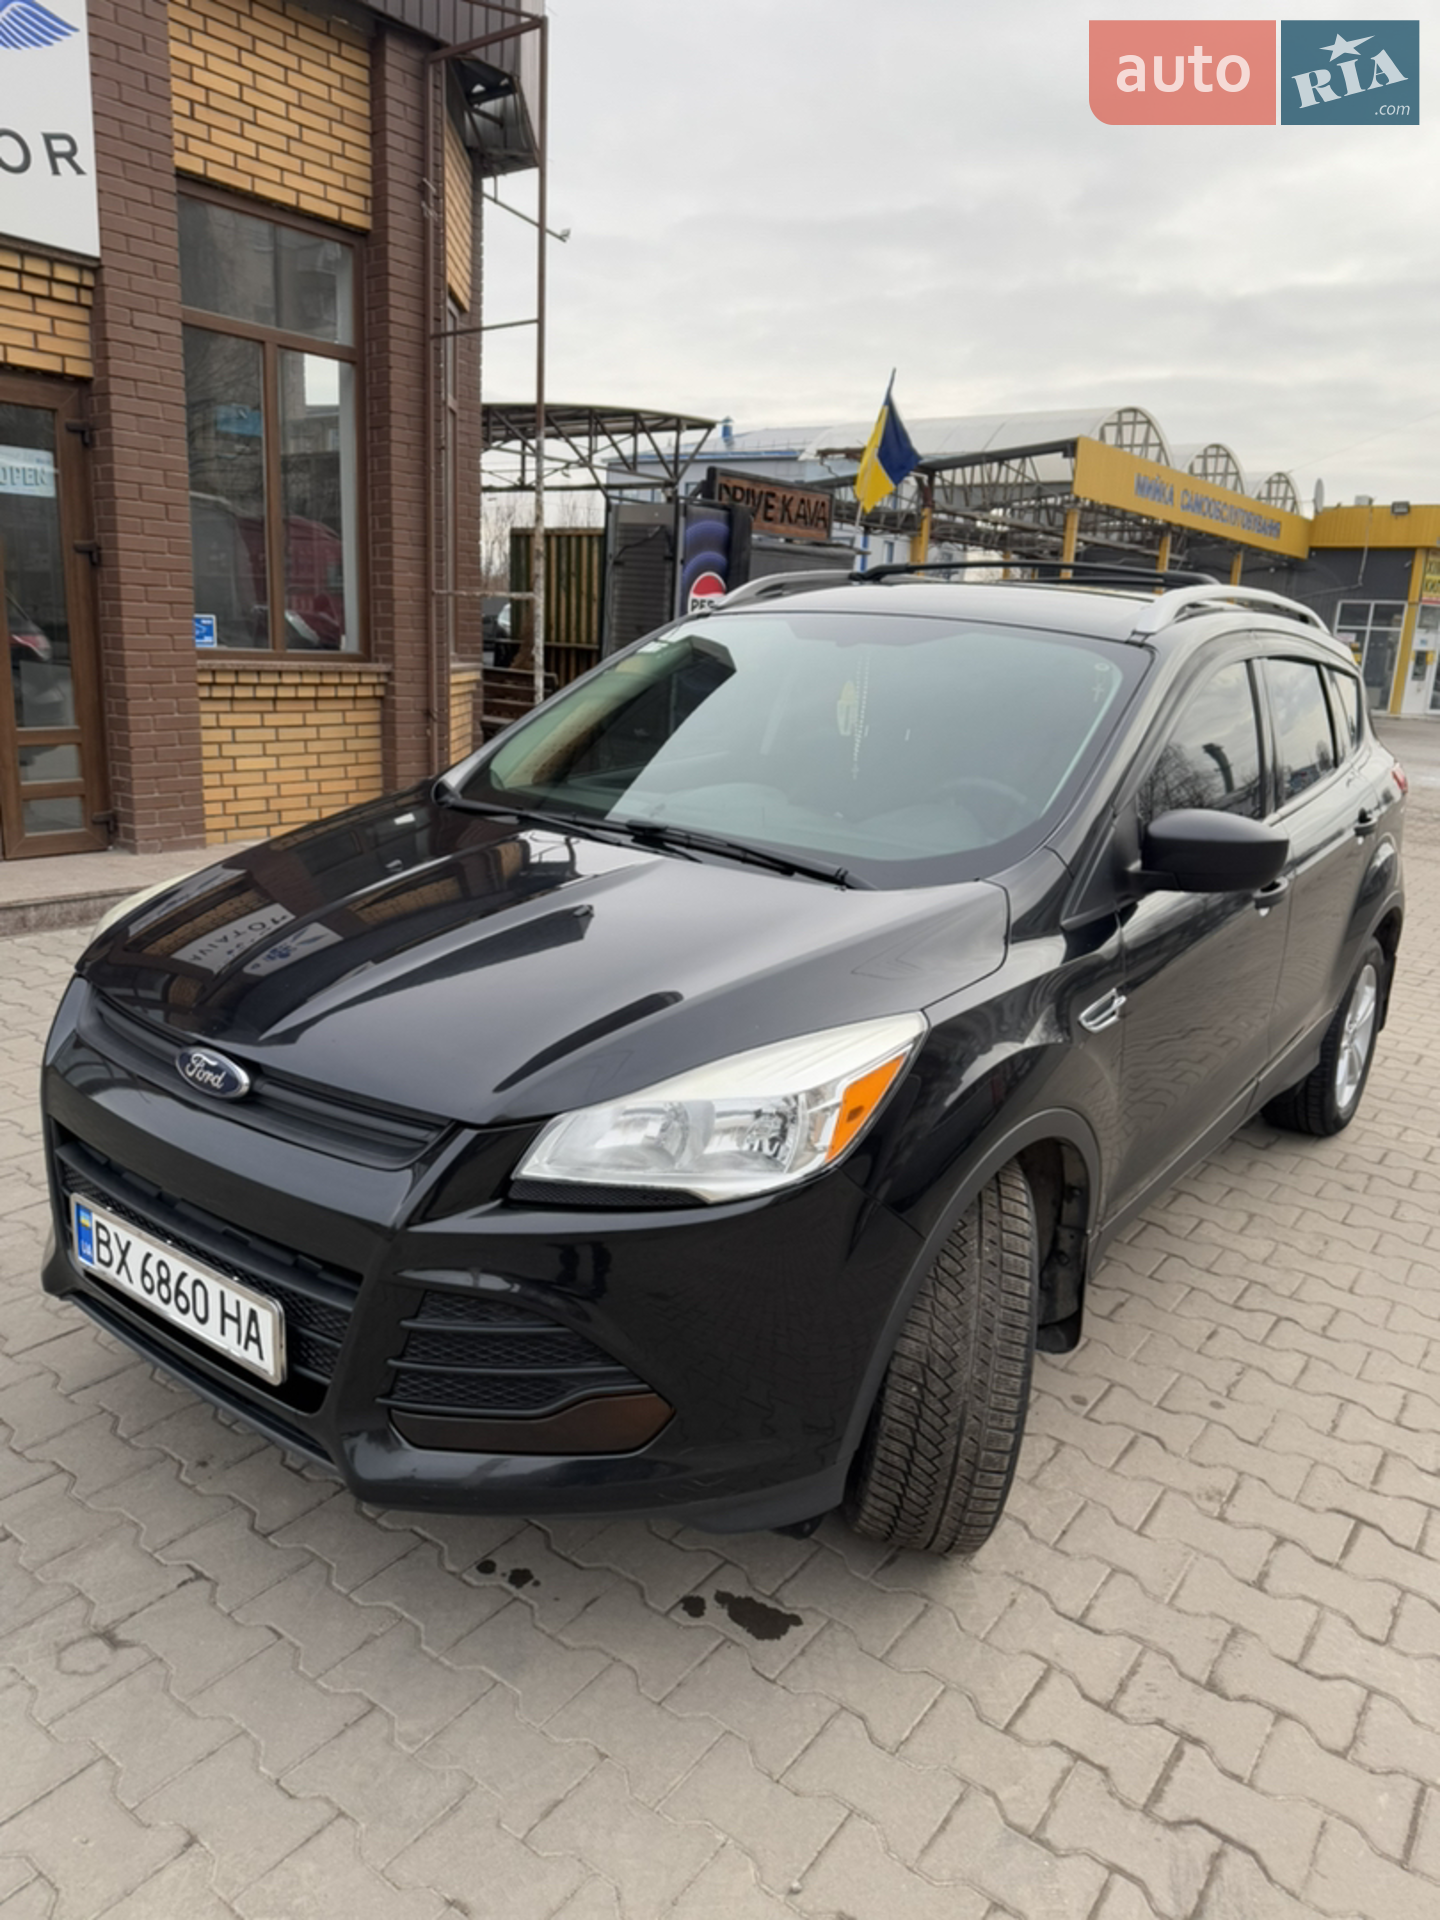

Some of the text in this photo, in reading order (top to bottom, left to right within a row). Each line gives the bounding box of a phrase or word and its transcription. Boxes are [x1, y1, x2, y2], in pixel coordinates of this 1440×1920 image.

[780, 494, 829, 529] KAVA
[185, 1053, 228, 1090] Ford
[95, 1219, 264, 1361] BX 6860 HA
